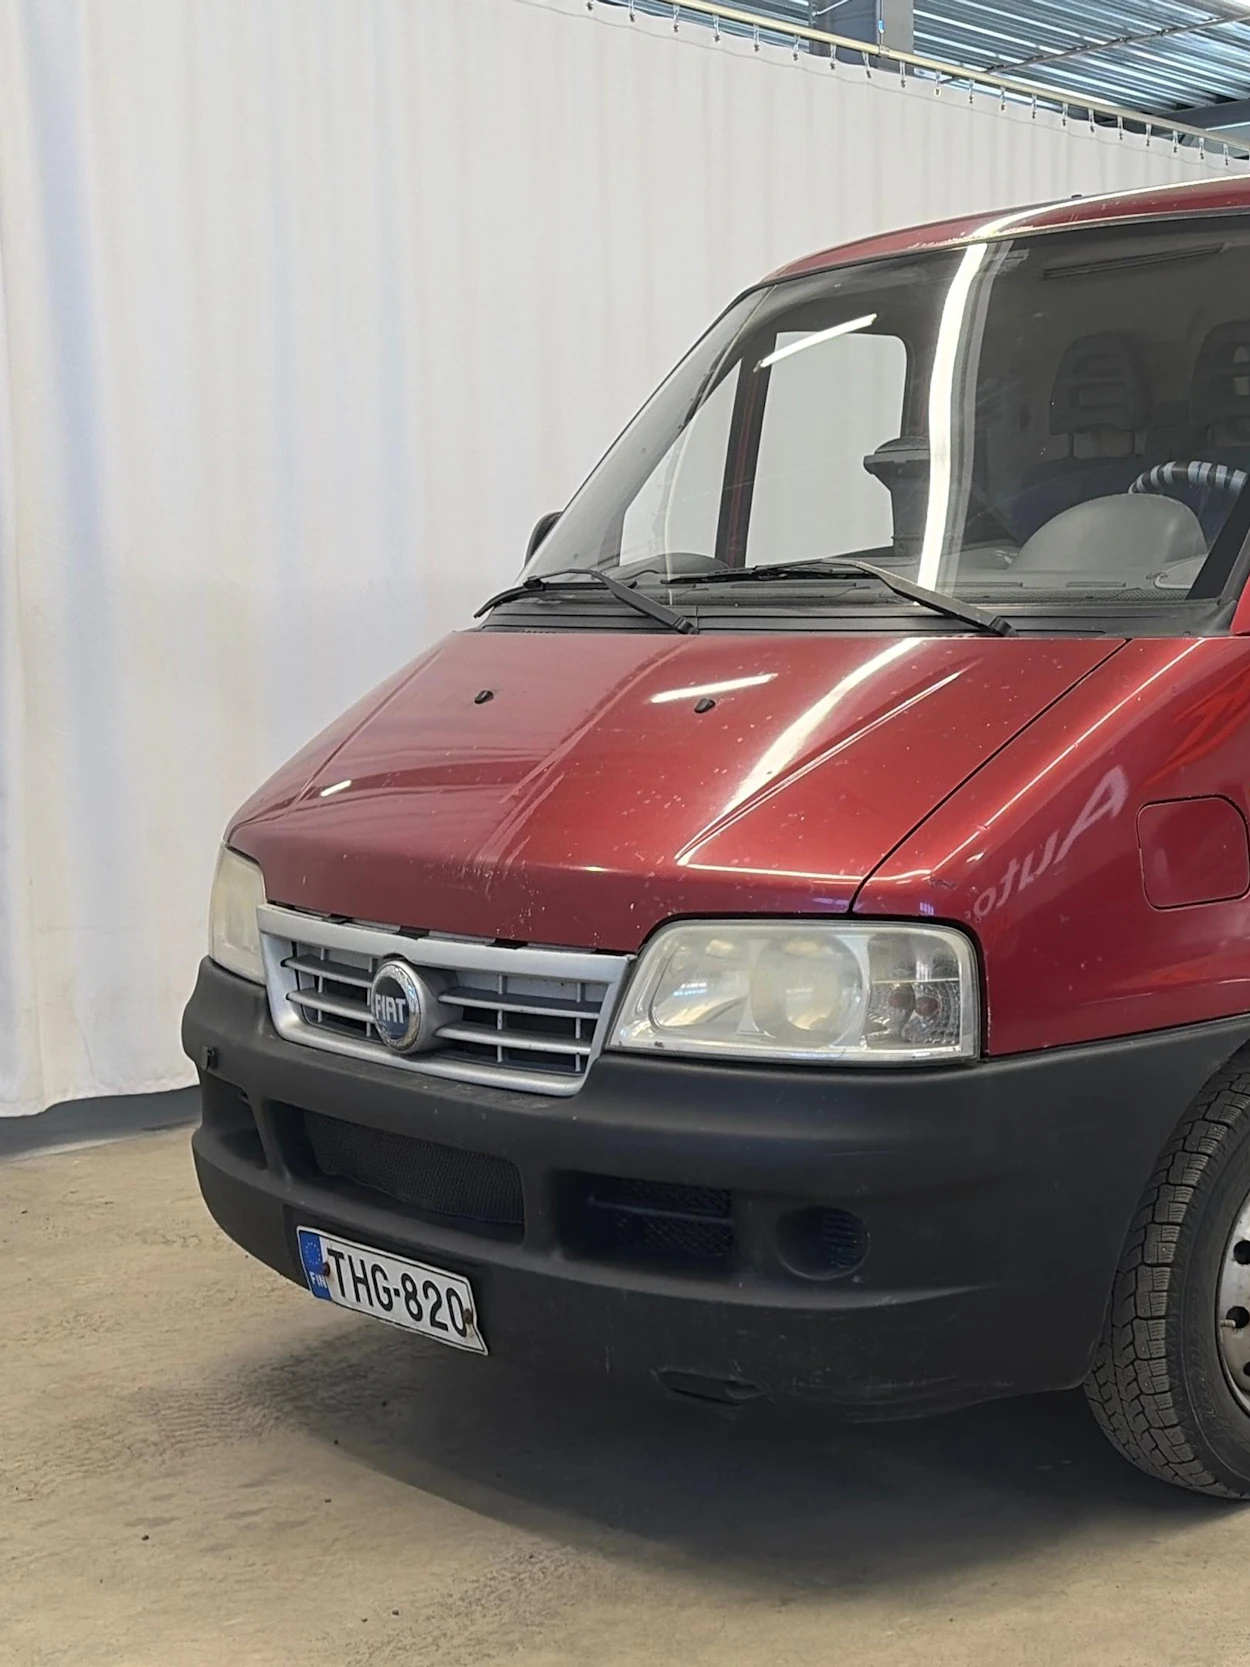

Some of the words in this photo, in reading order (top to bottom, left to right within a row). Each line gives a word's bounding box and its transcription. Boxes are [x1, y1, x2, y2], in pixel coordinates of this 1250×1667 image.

[375, 993, 406, 1024] FIAT
[309, 1271, 328, 1289] FIN
[327, 1248, 468, 1338] THG-820
